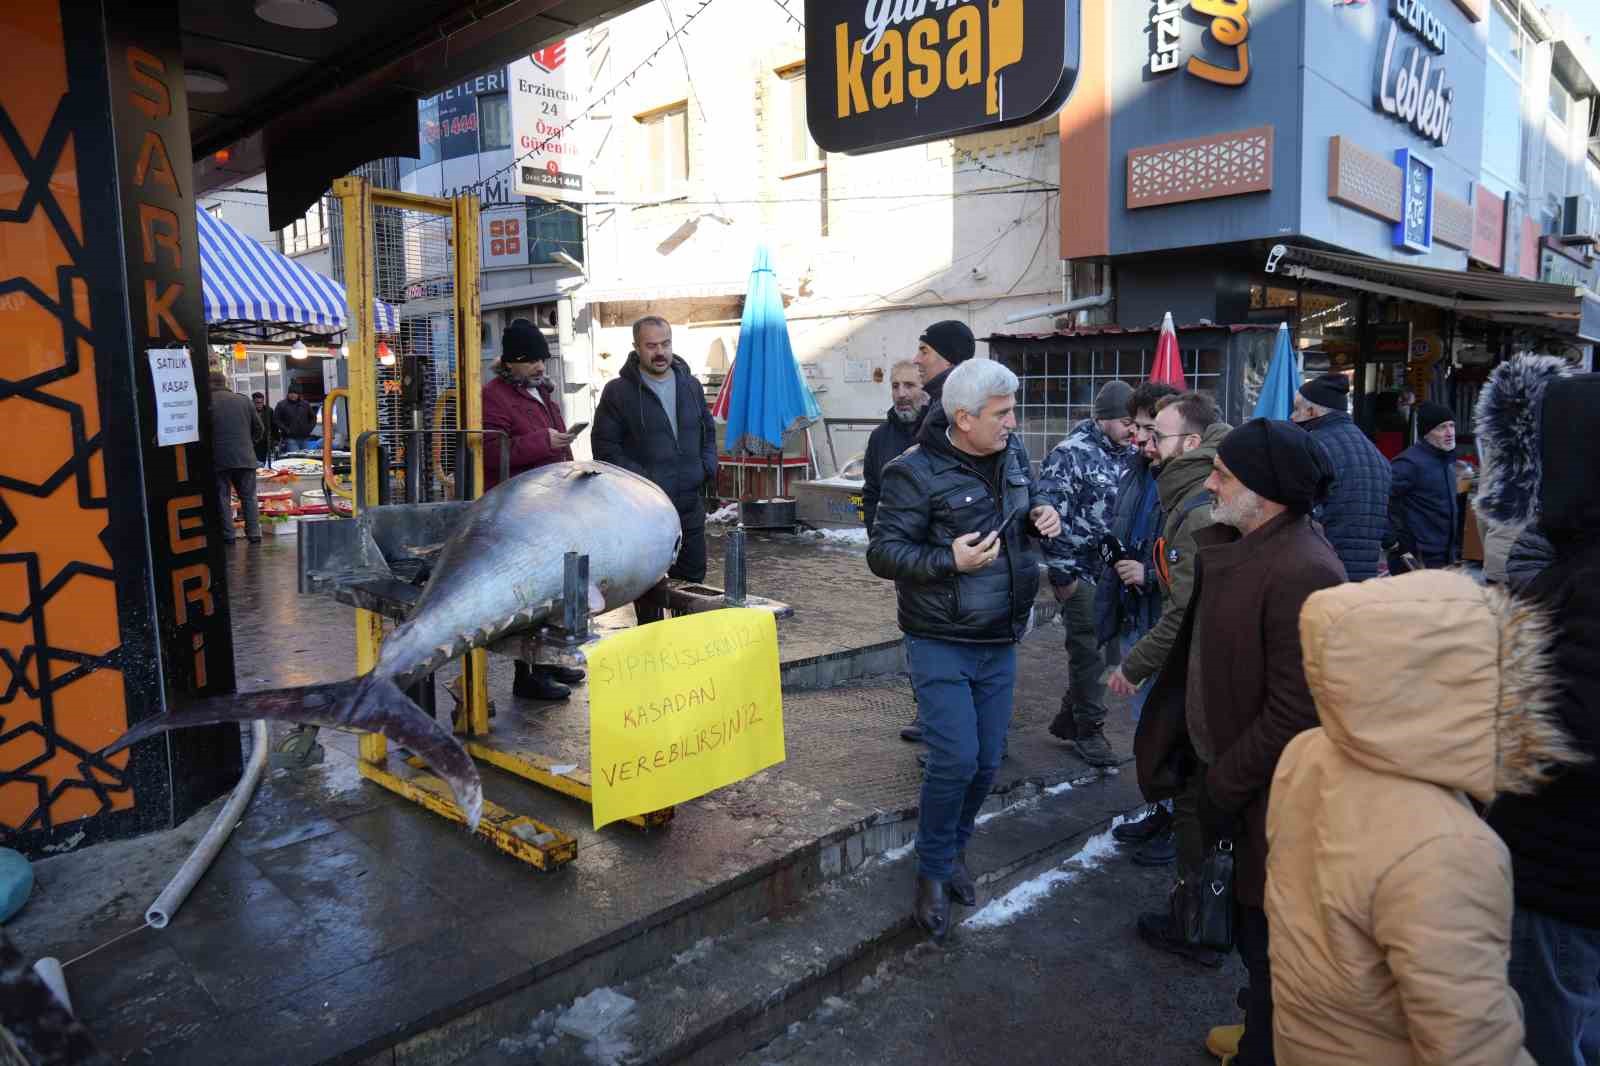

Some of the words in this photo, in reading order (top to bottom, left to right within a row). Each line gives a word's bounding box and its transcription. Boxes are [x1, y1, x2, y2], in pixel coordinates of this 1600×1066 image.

[835, 0, 1024, 119] kasap
[1380, 19, 1453, 147] Leblebi
[518, 78, 578, 102] Erzincan
[541, 101, 558, 116] 24
[623, 677, 717, 729] KASADAN
